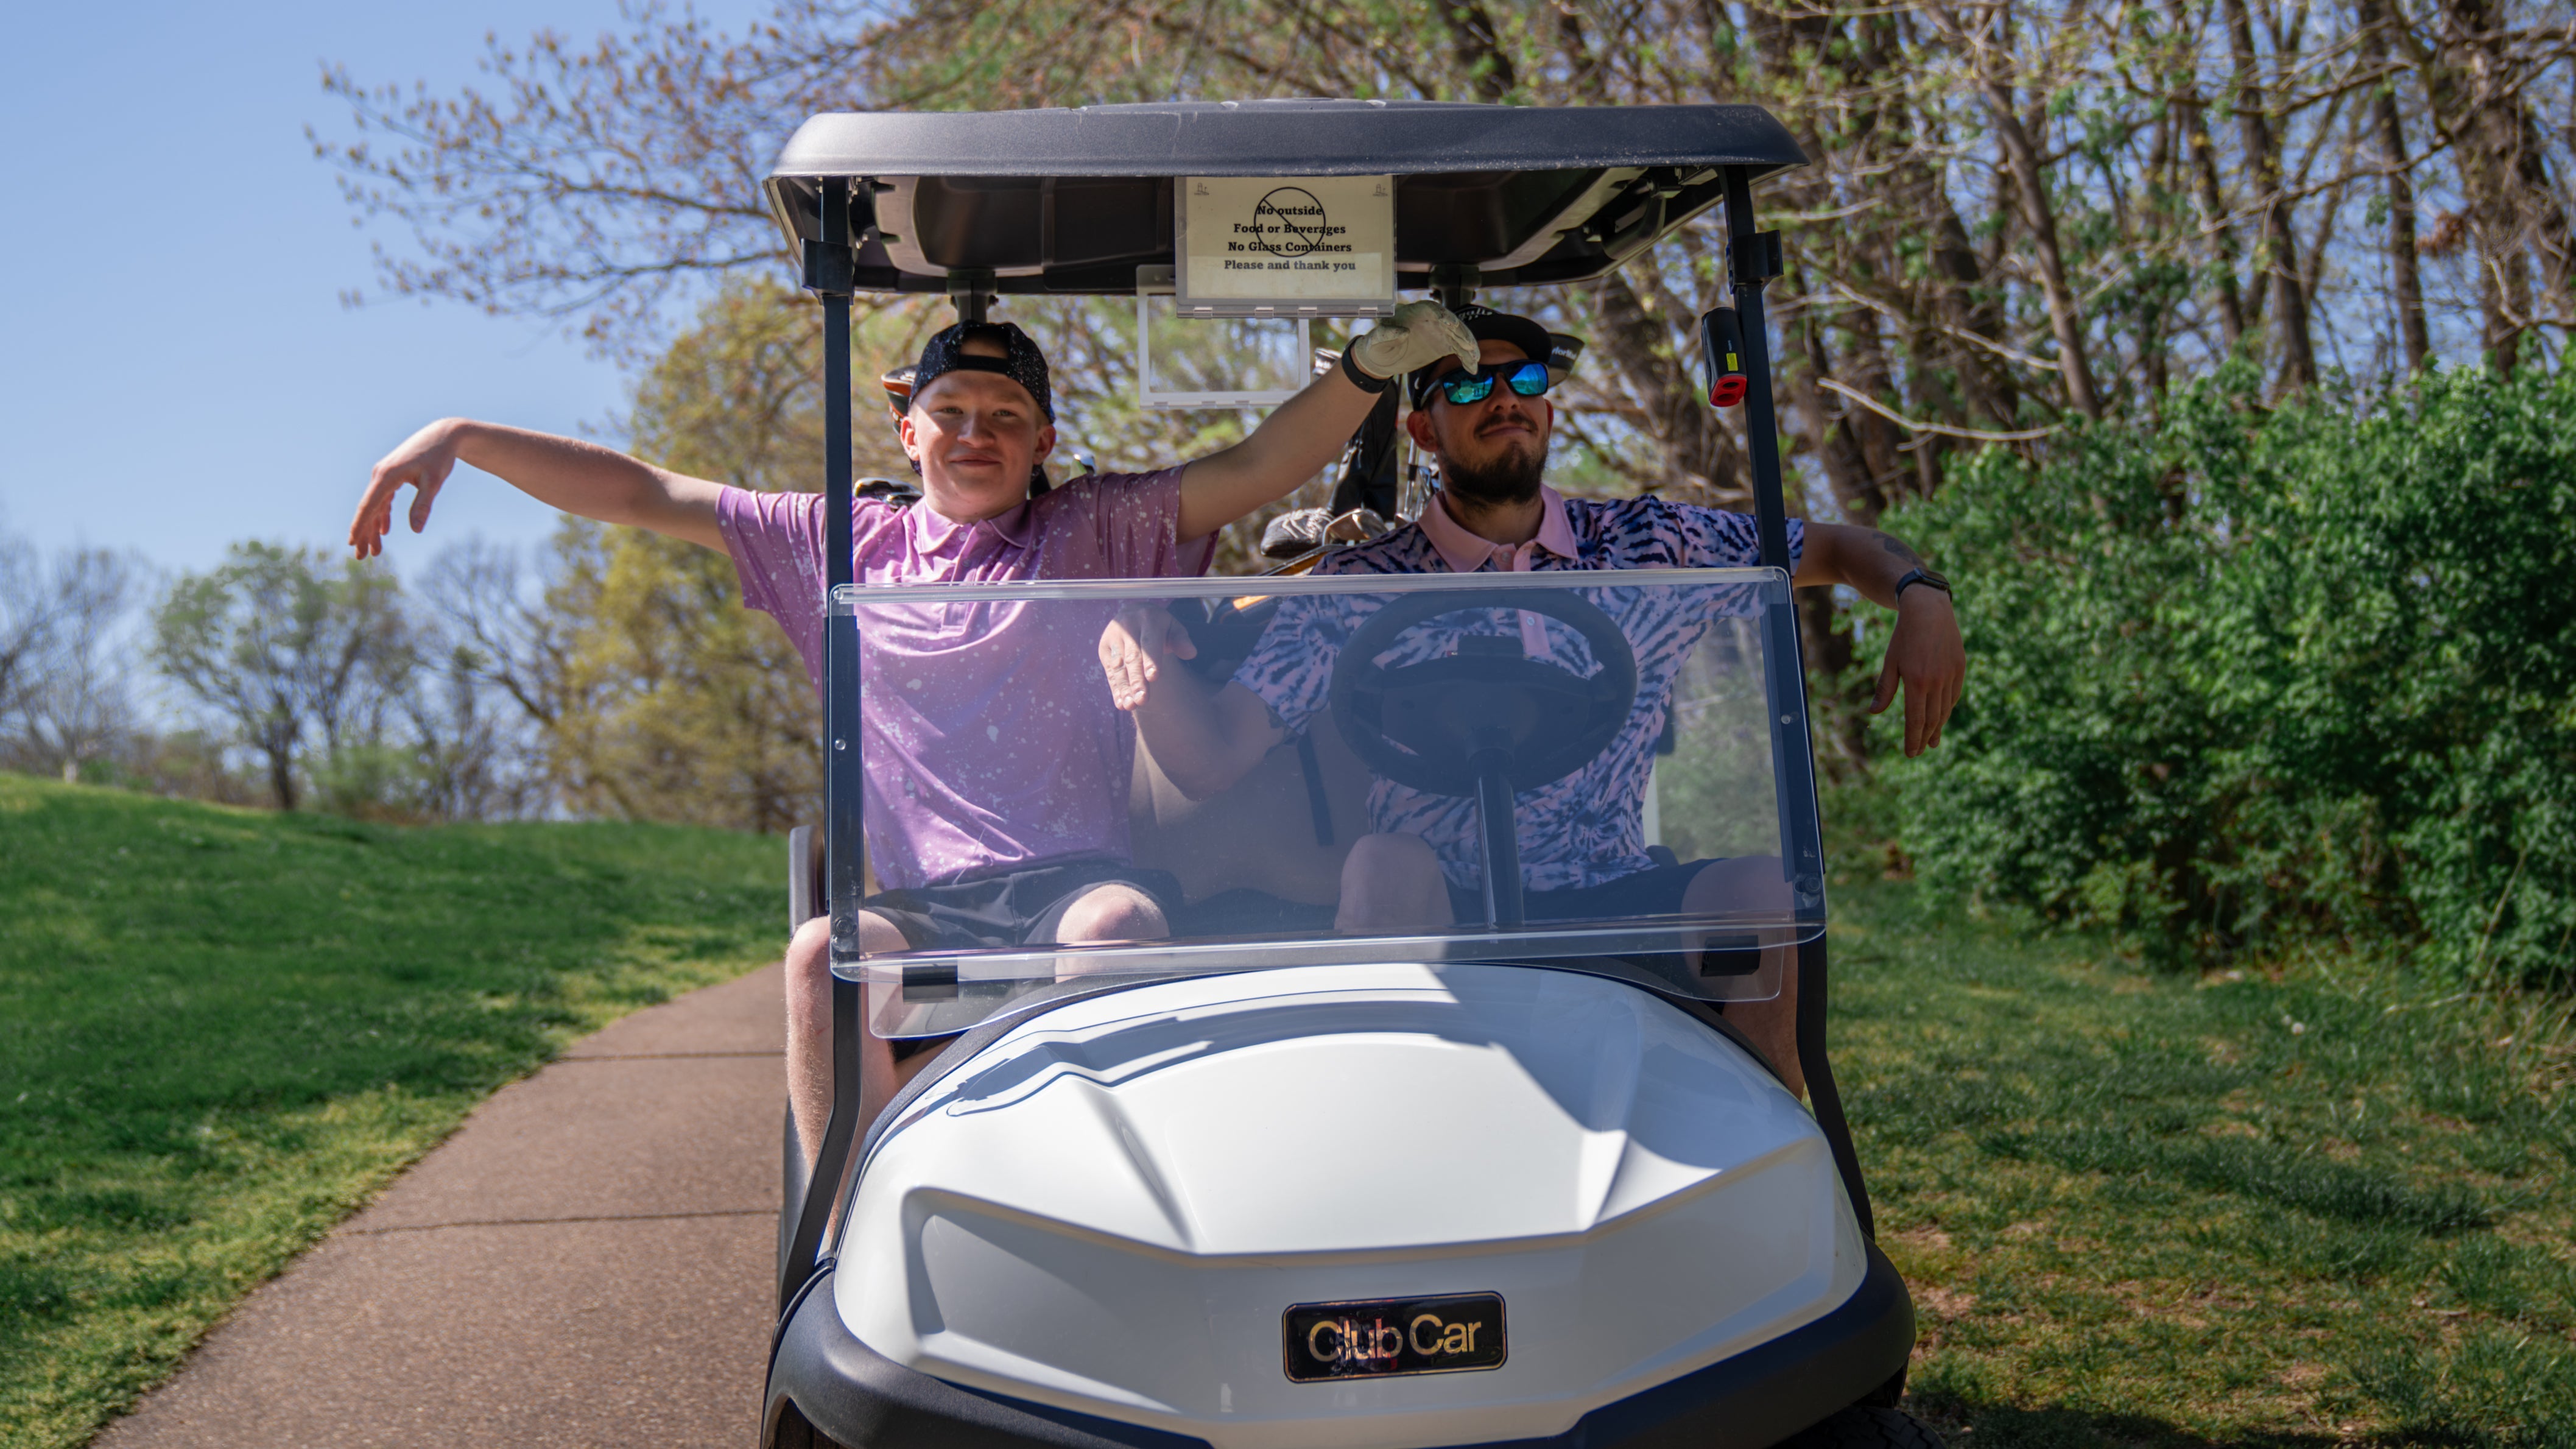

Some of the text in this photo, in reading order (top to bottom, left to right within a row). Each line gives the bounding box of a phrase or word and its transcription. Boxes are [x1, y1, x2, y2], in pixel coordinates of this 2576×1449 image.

[1257, 206, 1323, 215] No outside
[1234, 224, 1264, 233] Food
[1284, 225, 1346, 236] Beverages
[1228, 242, 1352, 252] No Glass Containers
[1224, 260, 1356, 273] Please and thank you
[1307, 1314, 1482, 1362] Club Car
